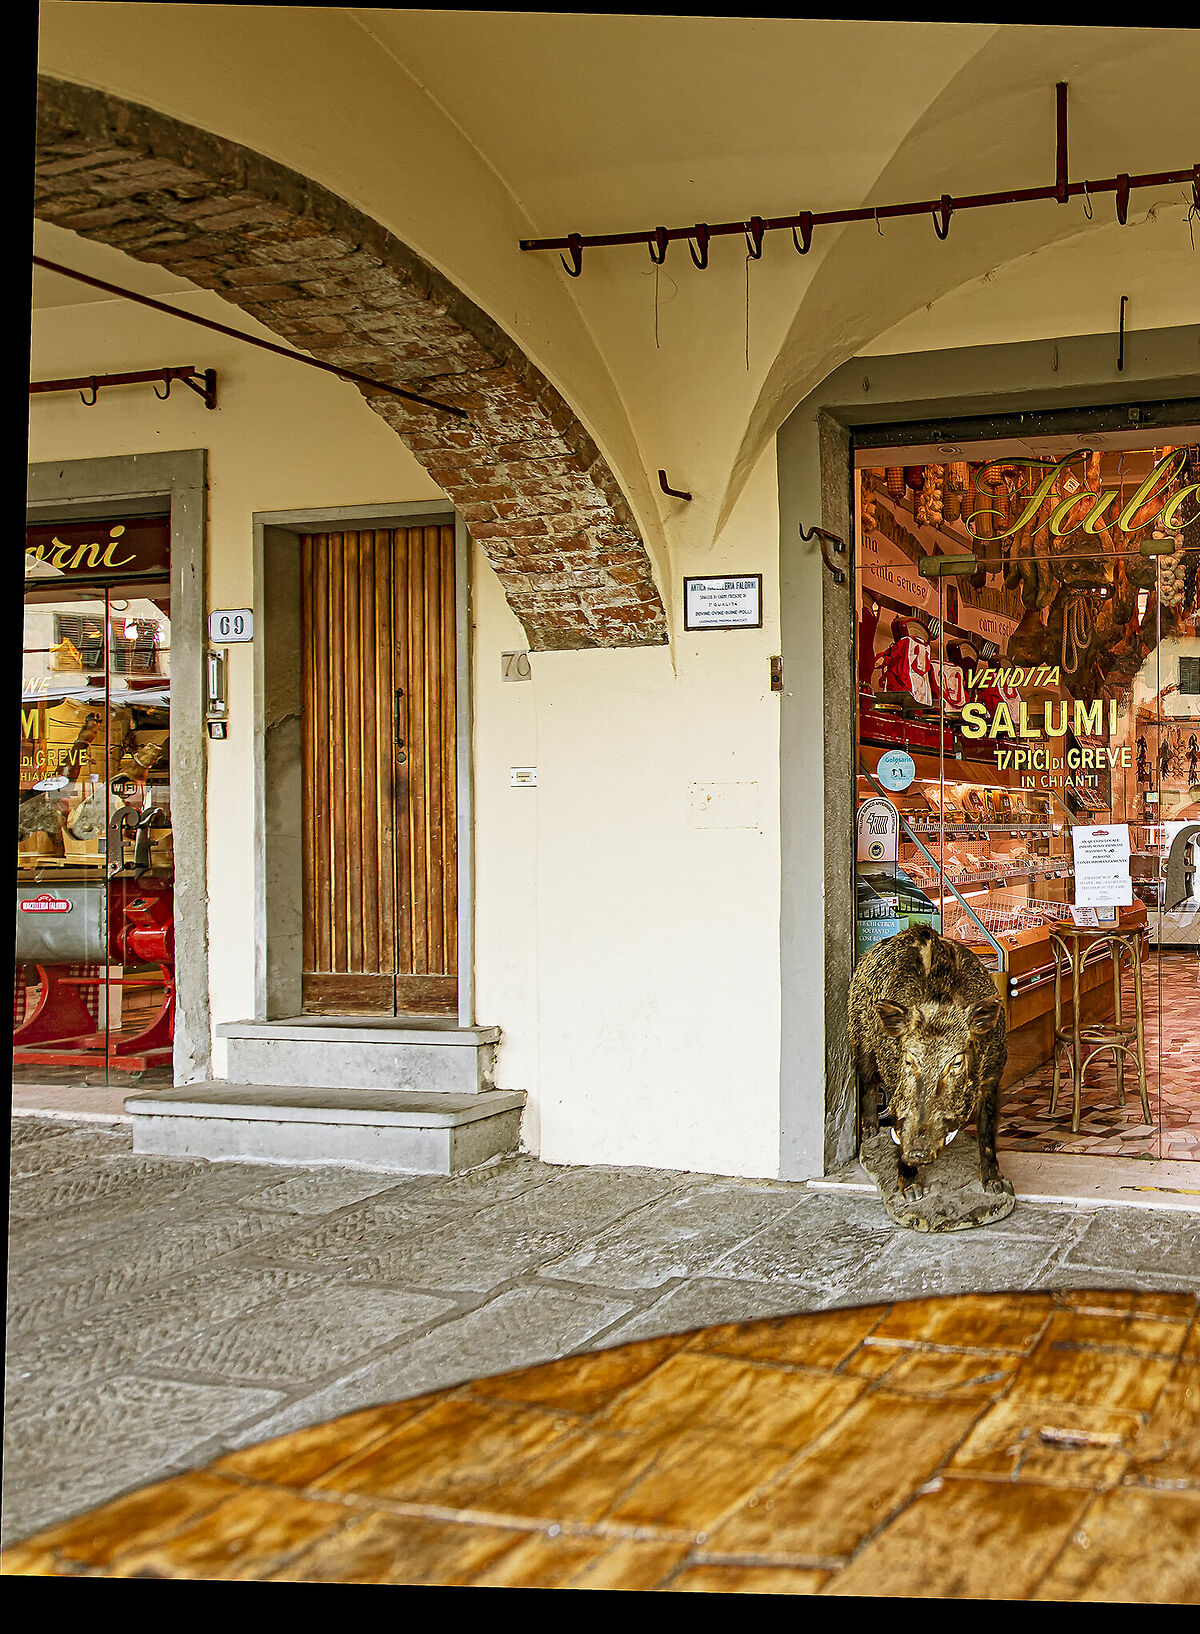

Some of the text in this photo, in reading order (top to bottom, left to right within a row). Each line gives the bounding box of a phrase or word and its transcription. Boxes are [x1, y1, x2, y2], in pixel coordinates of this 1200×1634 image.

[736, 581, 757, 590] FALORNI
[896, 575, 927, 599] senese
[219, 615, 245, 636] 69
[501, 653, 531, 677] 70
[967, 665, 1061, 689] VENDITA
[960, 698, 1118, 740] SALUMI
[36, 748, 87, 766] GREVE
[993, 746, 1132, 771] TIPICI DI GREVE
[1021, 774, 1099, 788] IN CHIANTI
